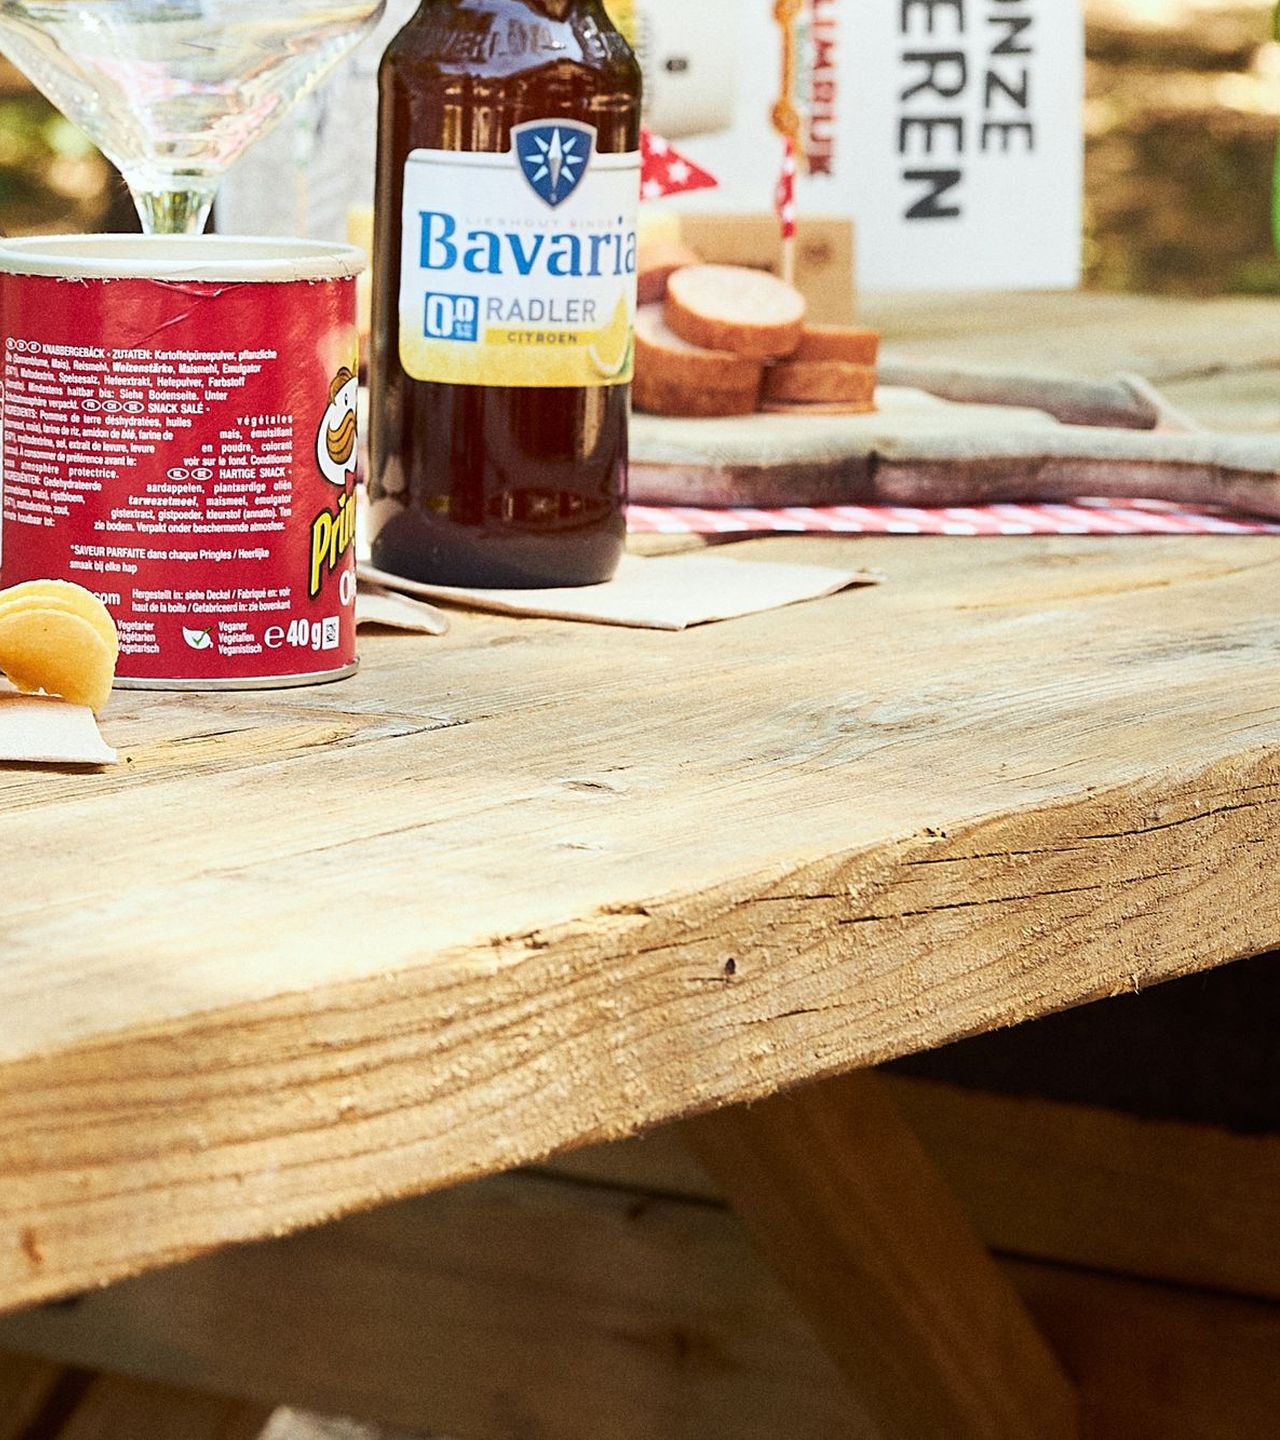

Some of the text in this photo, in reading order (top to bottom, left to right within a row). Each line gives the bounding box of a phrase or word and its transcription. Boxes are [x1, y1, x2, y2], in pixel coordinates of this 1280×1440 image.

[418, 210, 636, 277] Bavaria
[486, 296, 596, 323] RADLER
[507, 331, 577, 344] CITROEN
[112, 349, 153, 360] ZUTATEN:
[178, 363, 219, 375] Maismehl,
[222, 363, 262, 375] Emulgator
[104, 375, 153, 388] Hefeextrakt,
[156, 376, 204, 388] Hefepulver,
[208, 376, 245, 387] Farbstoff
[66, 385, 228, 401] haltbar bis: Siehe Bodenseite. Unter
[147, 402, 204, 414] SNACK SALÉ
[70, 412, 81, 424] de
[83, 414, 102, 425] terre
[104, 415, 162, 427] déshydratées,
[165, 416, 192, 427] huiles
[236, 414, 293, 427] végétales
[60, 426, 70, 436] de
[109, 429, 120, 439] de
[138, 430, 162, 441] farine
[162, 431, 173, 441] de
[250, 427, 293, 439] émulsifiant
[91, 440, 102, 451] de
[130, 442, 155, 453] levure
[201, 444, 213, 452] en
[221, 442, 254, 453] poudre,
[261, 440, 293, 451] colorant
[104, 455, 126, 466] avant
[183, 455, 200, 466] voir
[202, 457, 217, 466] sur
[217, 456, 227, 466] le
[228, 454, 248, 465] fond.
[68, 467, 286, 480] protectrice. HARTIGE SNACK
[146, 482, 267, 494] aardappelen, plantaardige
[128, 494, 292, 508] tarwezetmeel, emulgator
[158, 509, 204, 521] gistpoeder,
[206, 509, 241, 520] kleurstof
[94, 520, 249, 533] zie bodem. Verpakt onder beschermende
[106, 546, 146, 559] PARFAITE
[146, 549, 167, 560] dans
[168, 549, 198, 562] chaque
[199, 549, 232, 562] Pringles
[104, 561, 121, 572] elke
[122, 562, 138, 575] hap
[206, 588, 231, 600] Deckel
[149, 602, 159, 612] de
[116, 619, 155, 632] Vegetarier
[218, 621, 248, 632] Veganer
[217, 643, 262, 656] Veganistisch
